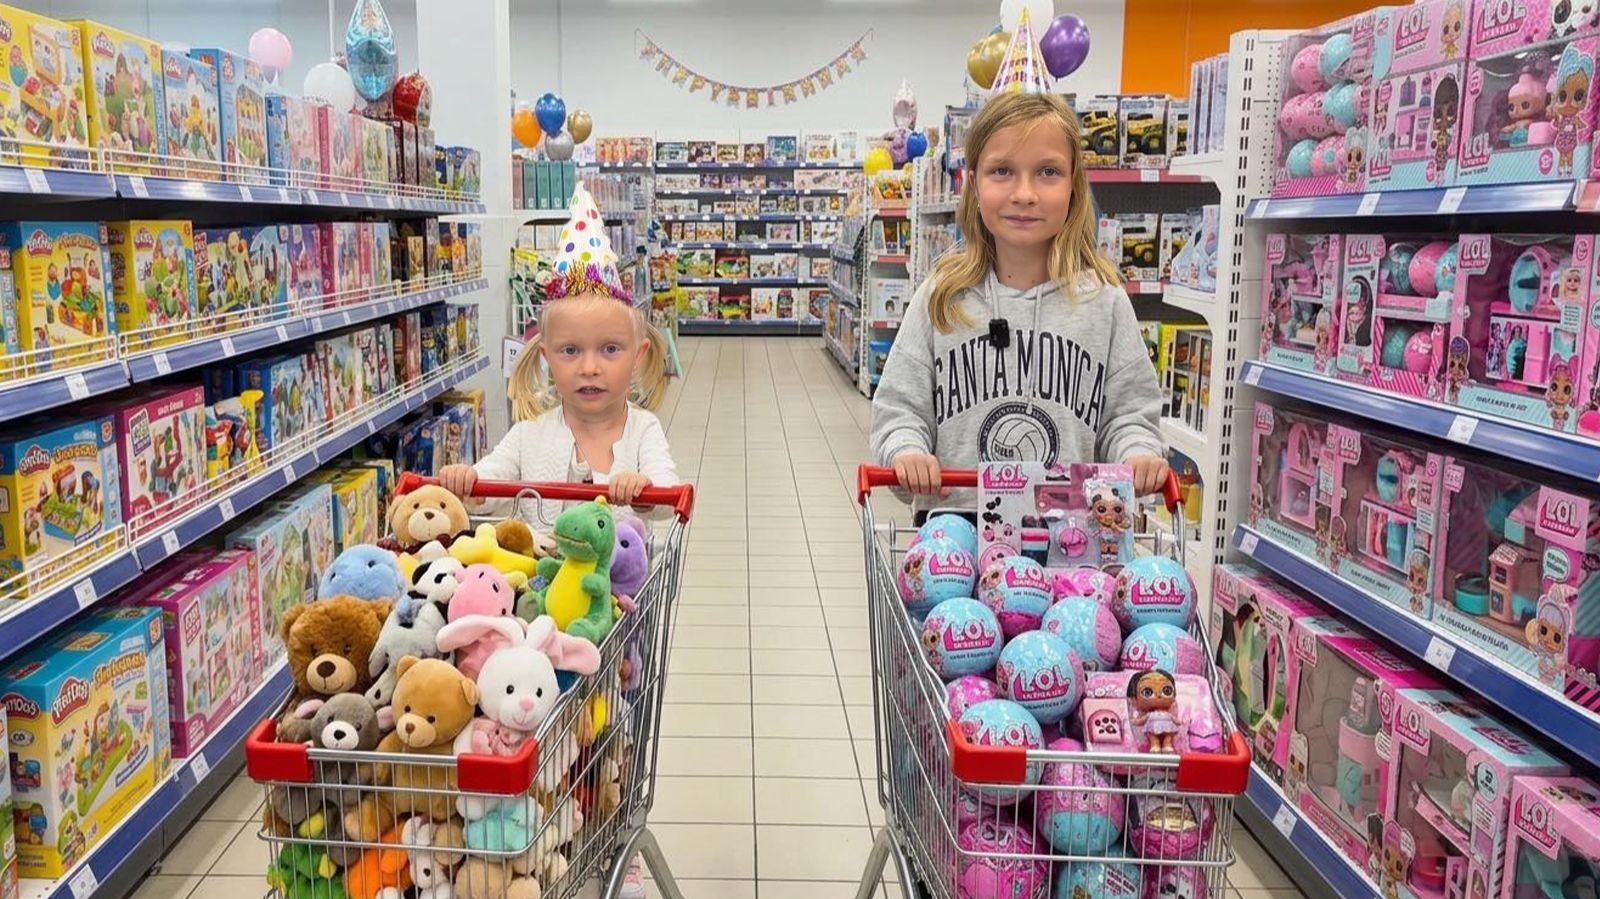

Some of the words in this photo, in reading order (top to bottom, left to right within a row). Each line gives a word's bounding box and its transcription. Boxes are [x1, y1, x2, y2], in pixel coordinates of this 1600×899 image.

[934, 333, 1009, 425] SANTA
[1016, 329, 1107, 433] MONICA
[989, 464, 1028, 481] LOL
[1546, 496, 1581, 527] LOL
[1139, 576, 1184, 596] LOL
[951, 619, 996, 642] LOL
[1019, 665, 1071, 692] LOL
[988, 722, 1038, 746] LOL
[1399, 704, 1429, 739] LOL
[1521, 793, 1558, 839] LOL
